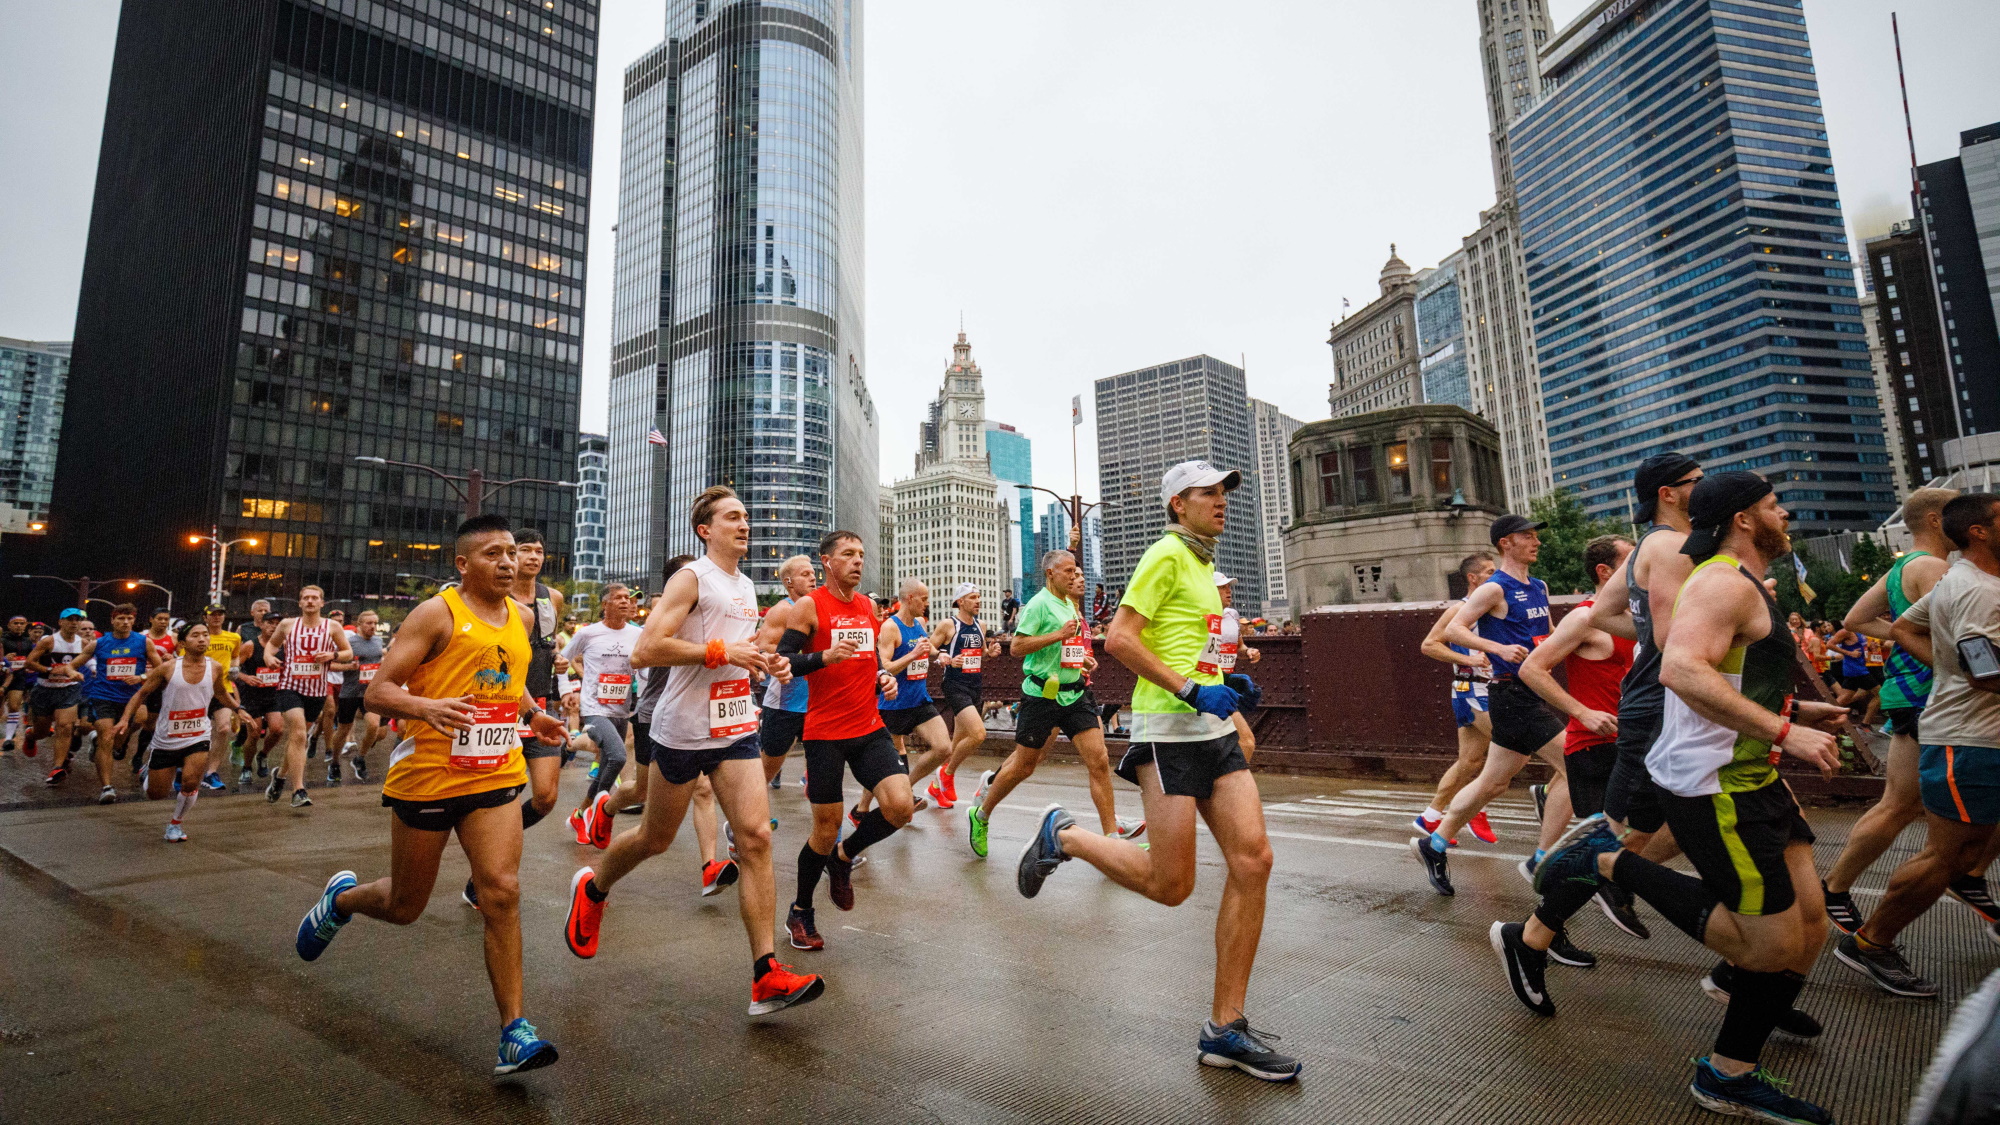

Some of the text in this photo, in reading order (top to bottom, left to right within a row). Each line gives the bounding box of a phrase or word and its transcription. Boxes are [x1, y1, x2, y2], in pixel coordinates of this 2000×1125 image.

[1065, 647, 1071, 658] B
[911, 661, 916, 671] B
[965, 657, 970, 666] B
[118, 665, 133, 673] 7271
[294, 664, 299, 672] B
[602, 685, 627, 695] B 9197
[718, 699, 748, 719] B 8107
[174, 718, 202, 731] B 7218
[458, 726, 515, 747] B 10273
